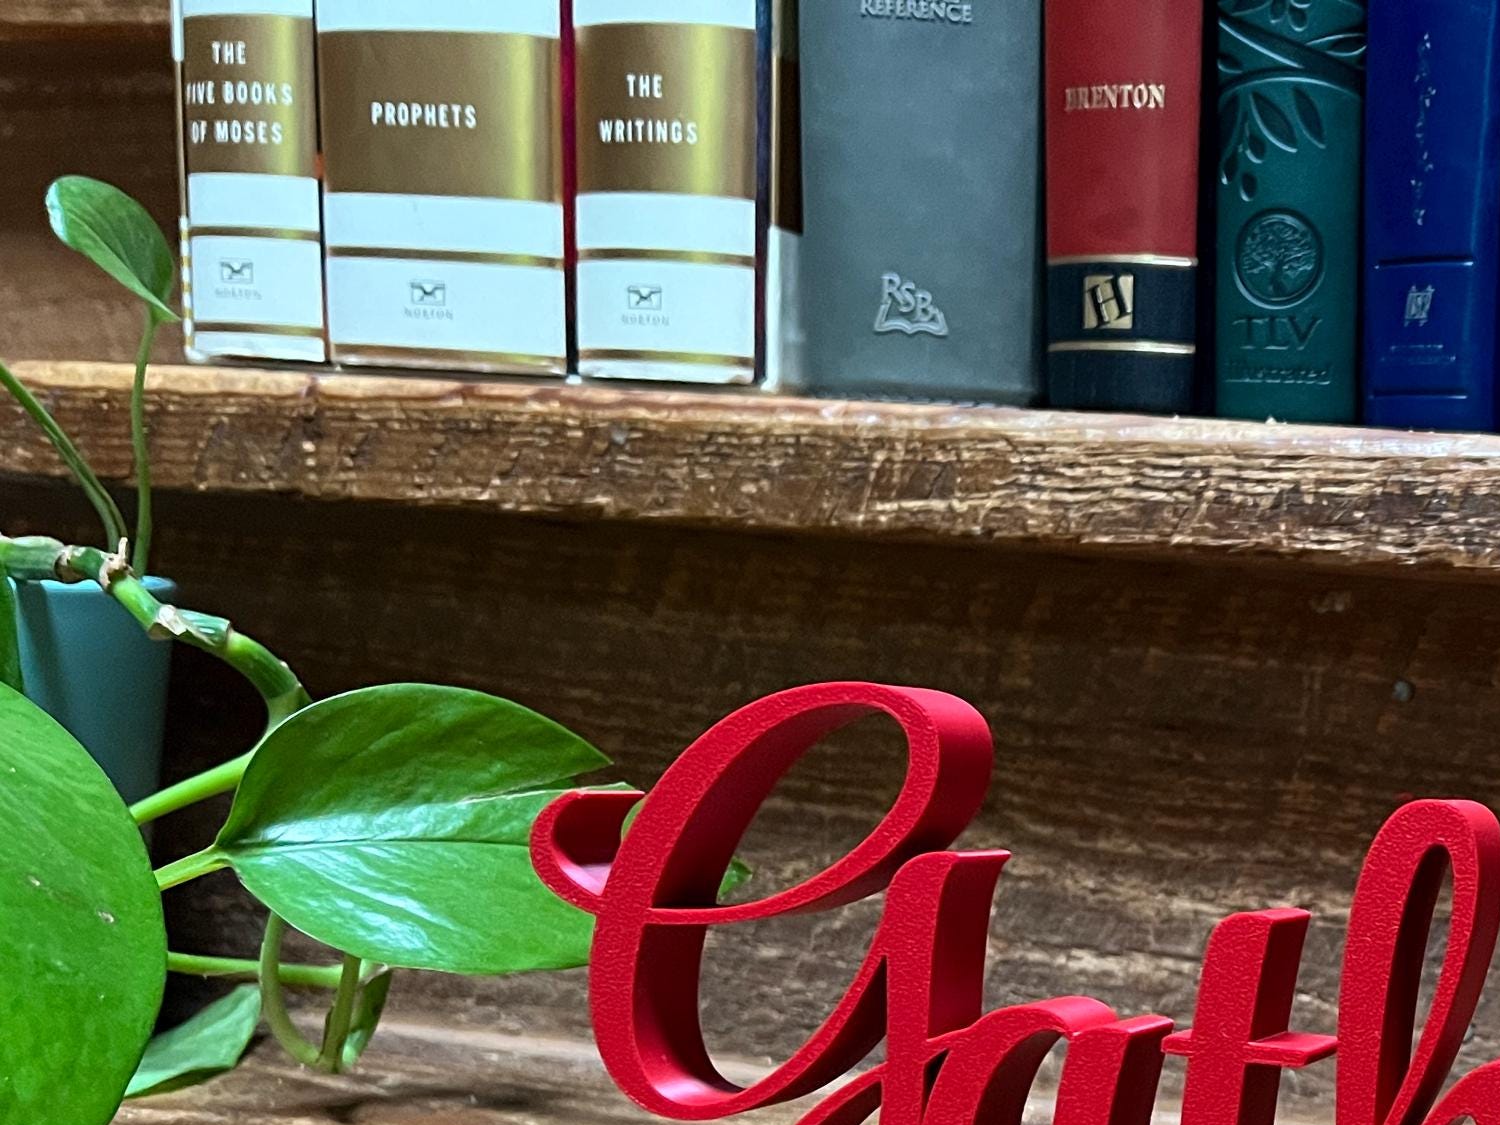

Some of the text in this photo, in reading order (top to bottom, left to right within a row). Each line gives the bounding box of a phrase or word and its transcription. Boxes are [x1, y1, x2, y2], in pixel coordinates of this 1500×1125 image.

[210, 40, 247, 65] THE
[222, 80, 294, 107] BOOKS
[625, 73, 664, 98] THE
[1064, 83, 1166, 112] BRENTON
[371, 101, 478, 129] PROPHETS
[190, 120, 283, 145] OF MOSES
[599, 118, 699, 145] WRITINGS
